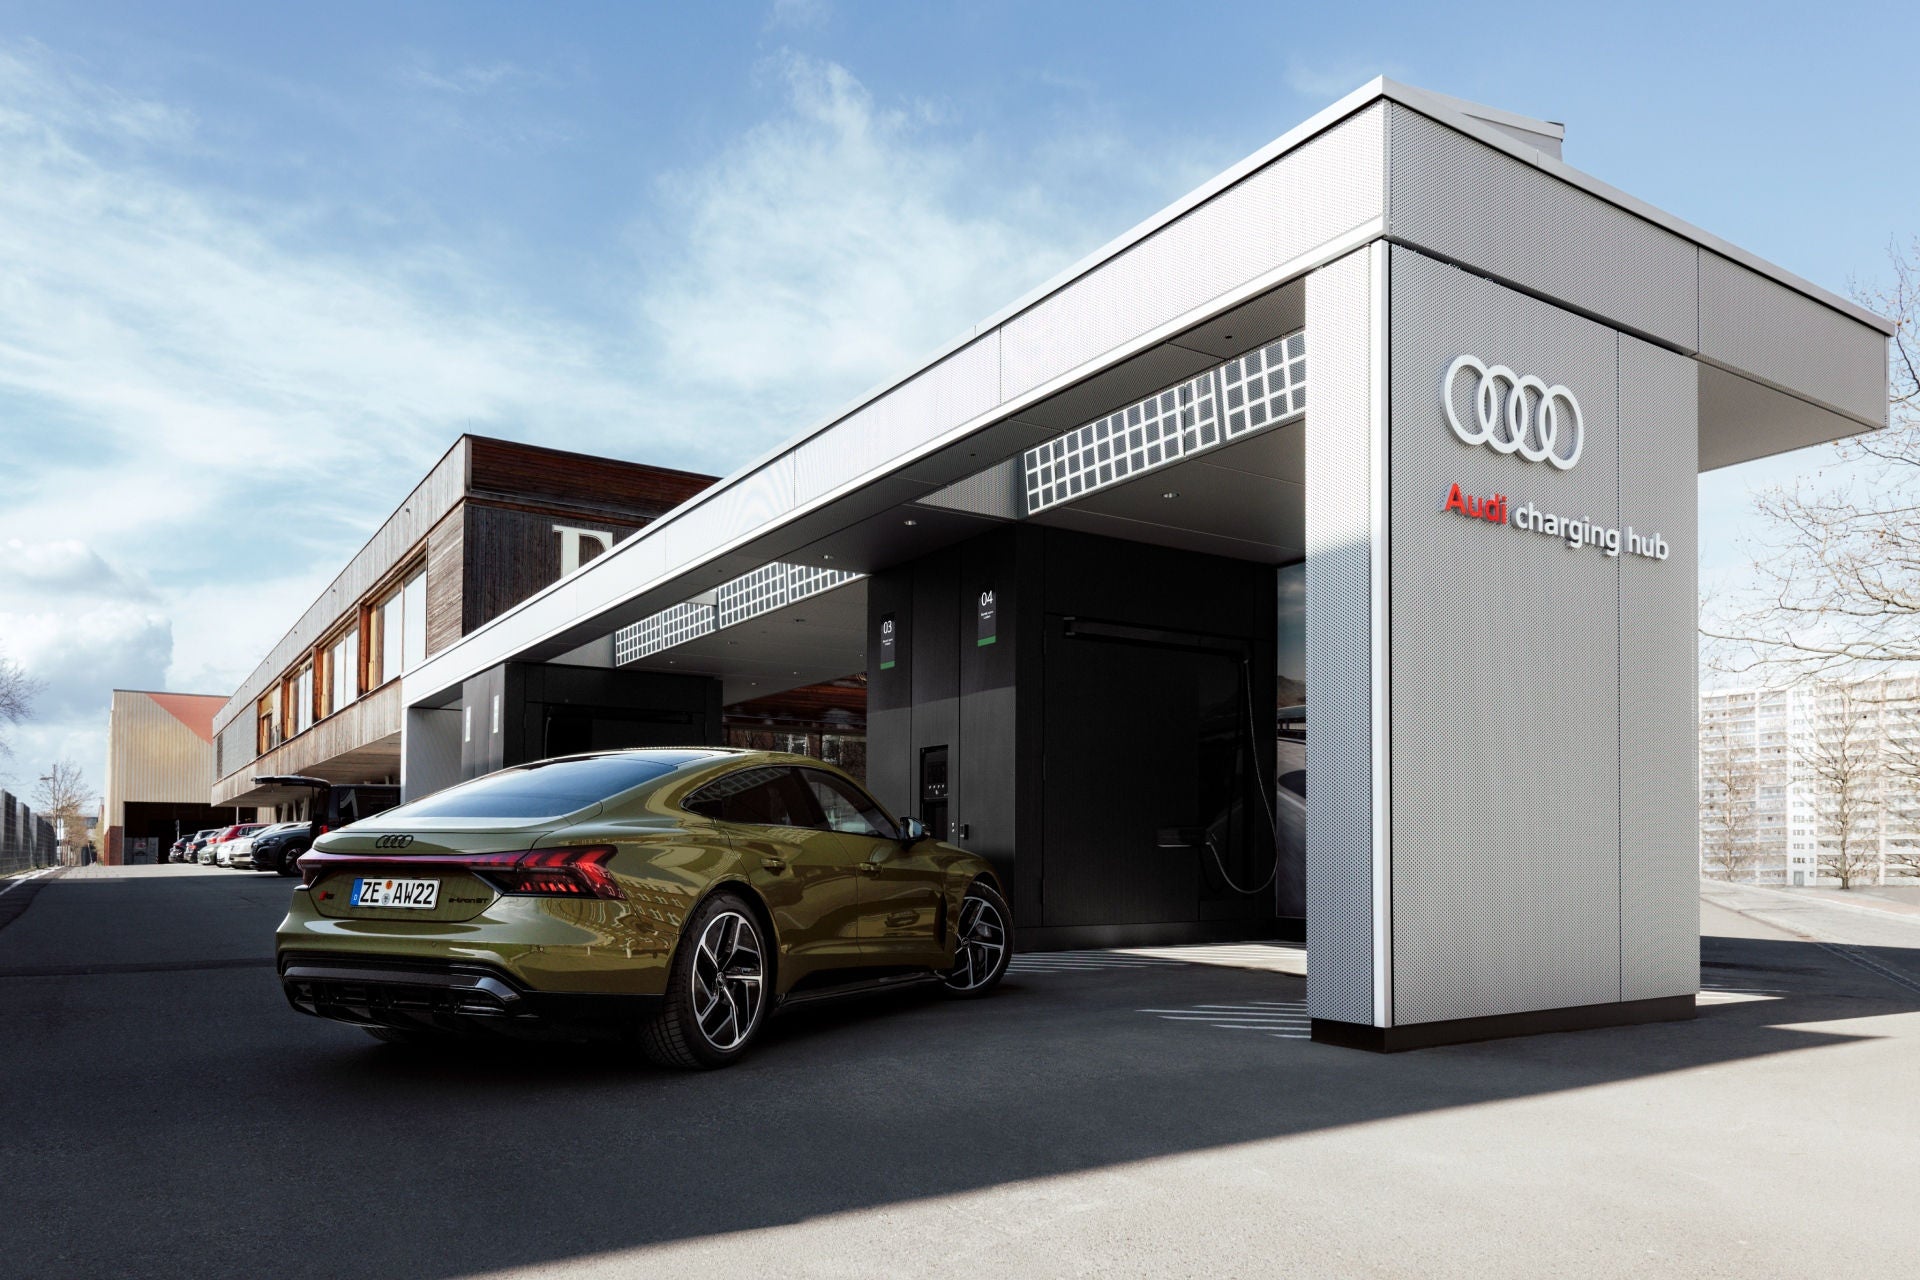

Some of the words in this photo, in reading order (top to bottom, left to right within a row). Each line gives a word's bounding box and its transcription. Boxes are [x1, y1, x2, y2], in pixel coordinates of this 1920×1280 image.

[1443, 481, 1507, 525] Audi
[1513, 501, 1620, 557] charging
[1626, 525, 1669, 560] hub
[981, 590, 993, 606] 04
[883, 620, 892, 634] 03
[360, 881, 382, 903] ZE
[392, 882, 435, 905] AW22
